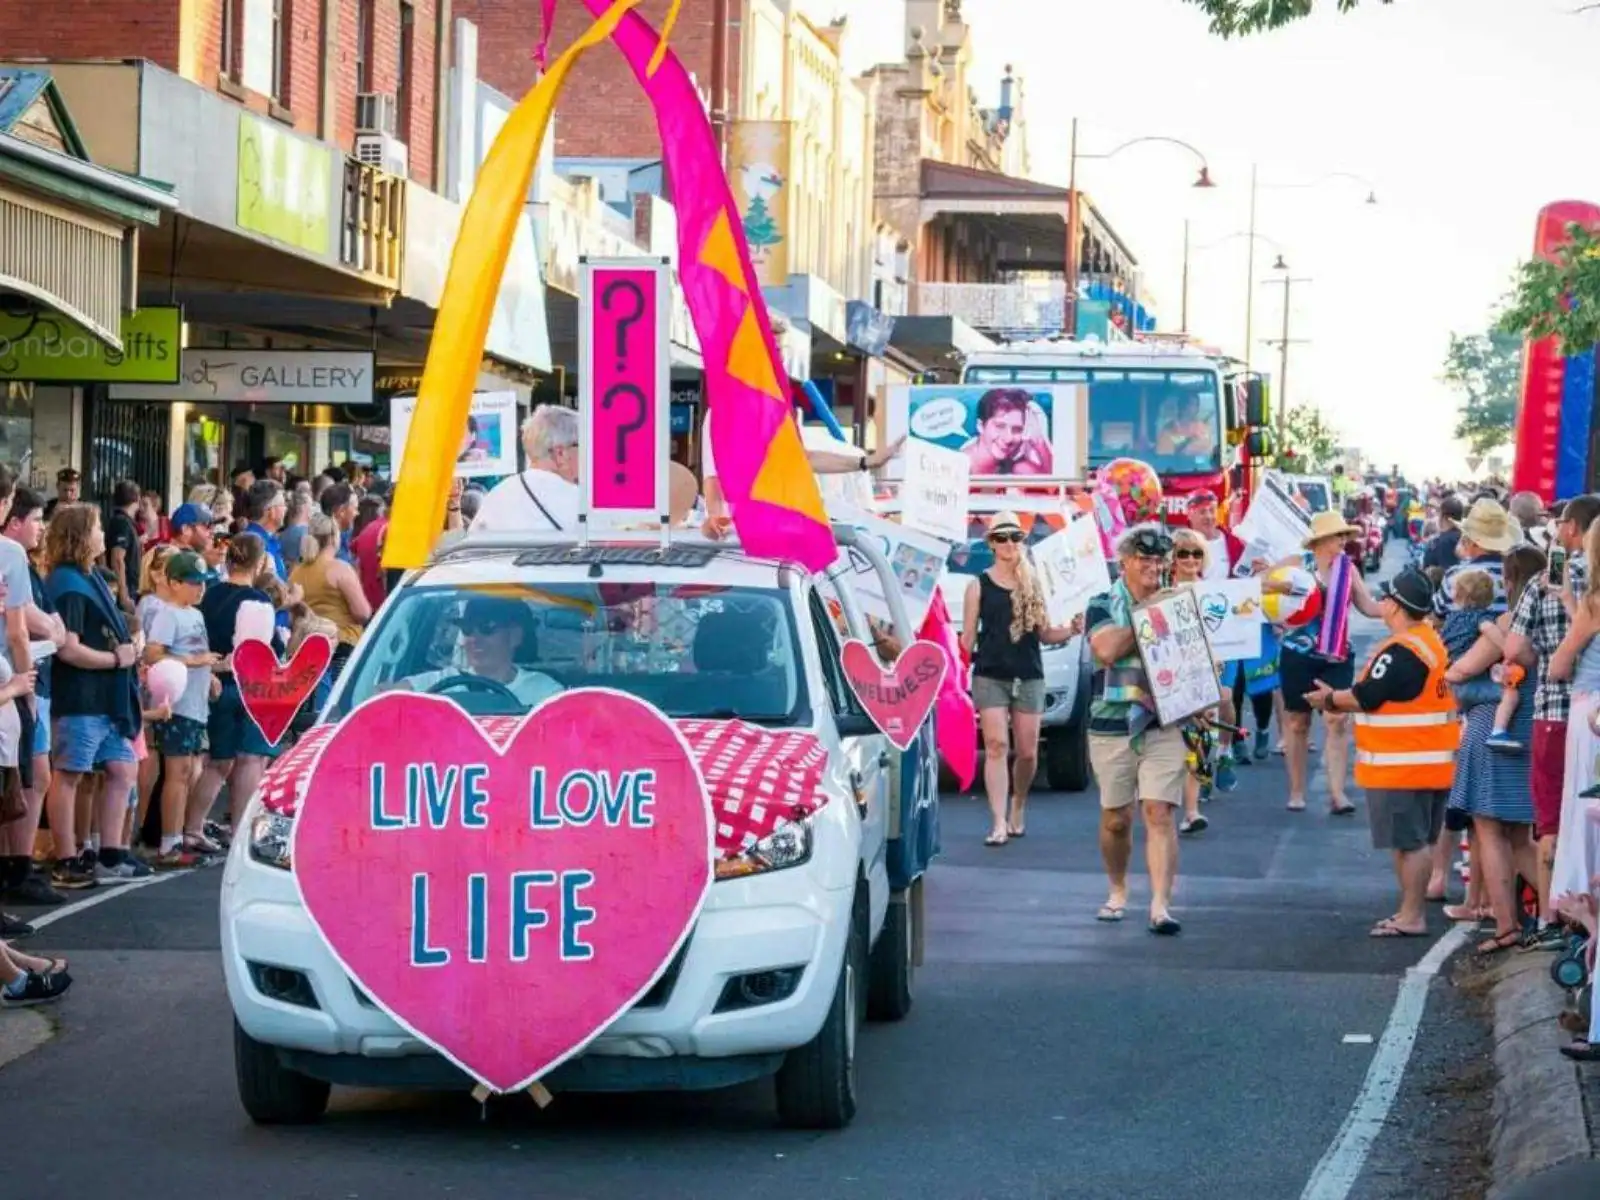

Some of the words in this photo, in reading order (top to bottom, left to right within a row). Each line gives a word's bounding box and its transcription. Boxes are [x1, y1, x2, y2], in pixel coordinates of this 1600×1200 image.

[241, 366, 365, 388] GALLERY
[1157, 495, 1189, 515] FIR
[852, 656, 939, 705] WELLNESS
[1371, 653, 1393, 679] 6
[370, 762, 489, 829] LIVE
[530, 766, 656, 828] LOVE
[410, 869, 596, 967] LIFE
